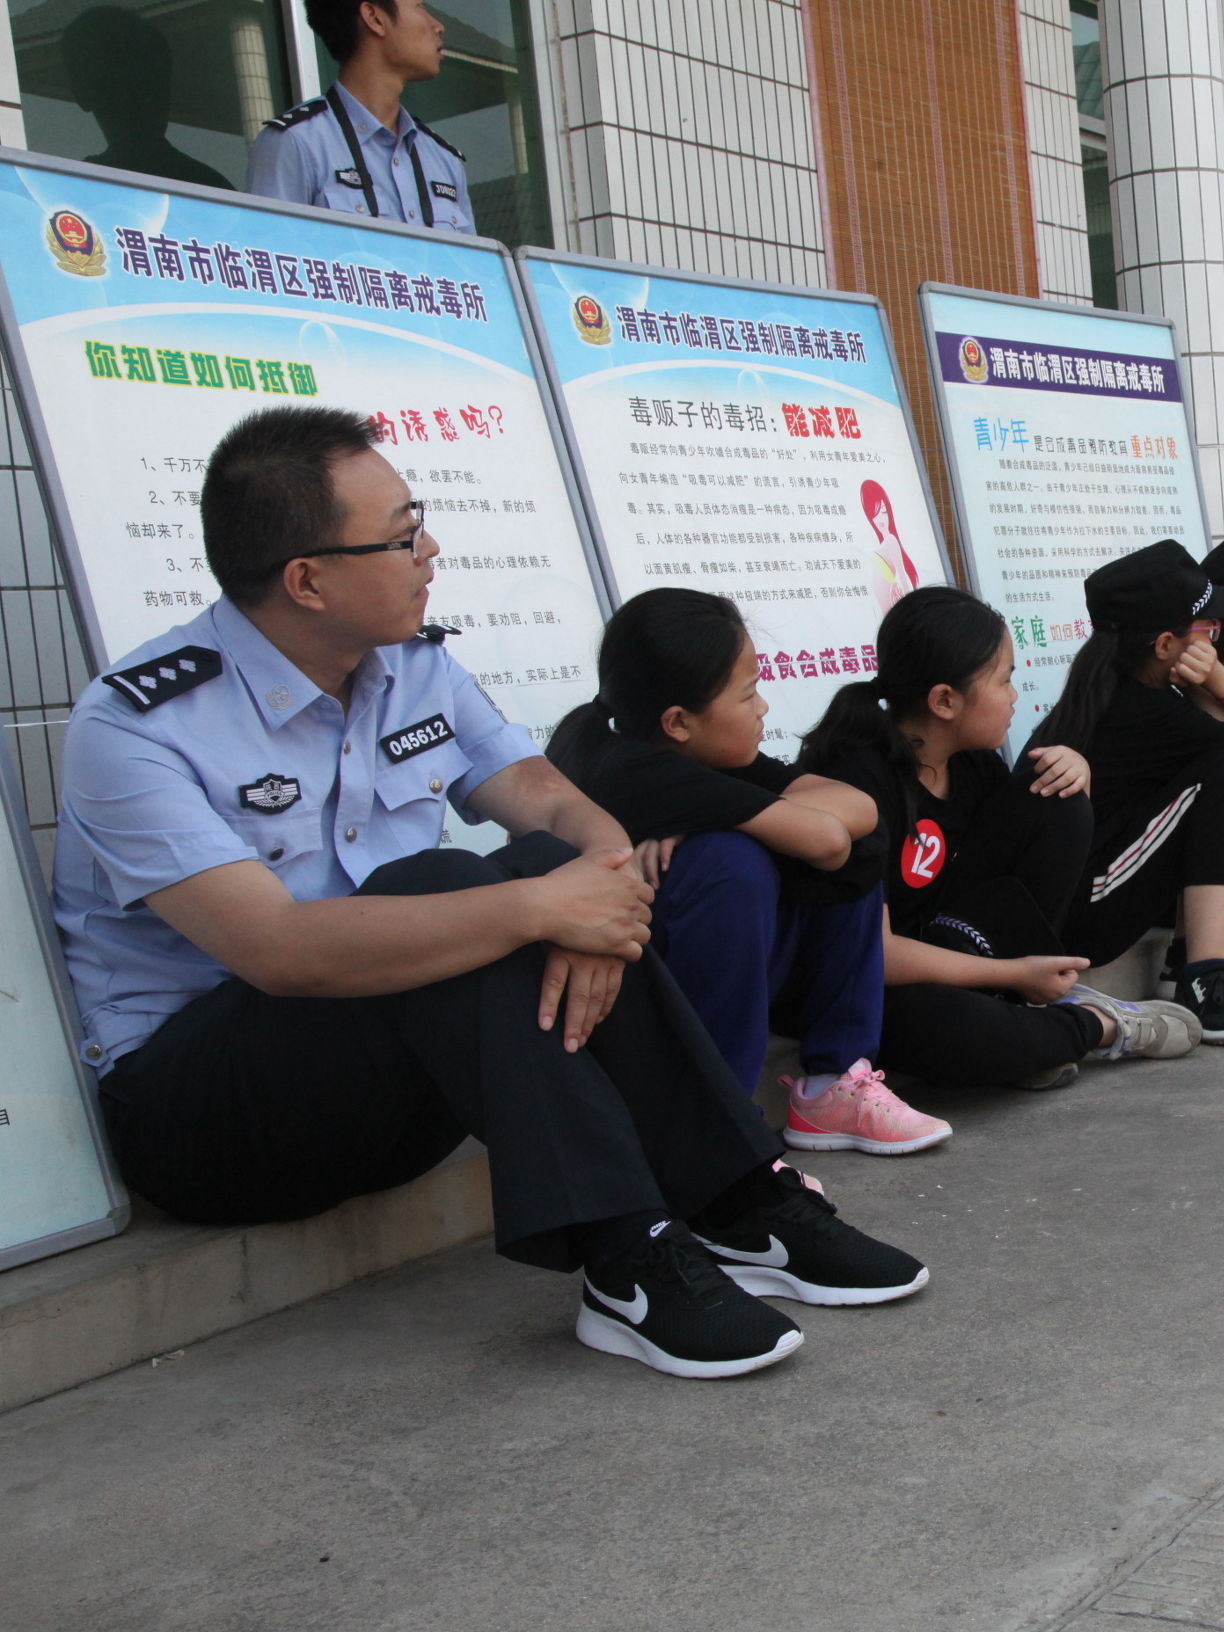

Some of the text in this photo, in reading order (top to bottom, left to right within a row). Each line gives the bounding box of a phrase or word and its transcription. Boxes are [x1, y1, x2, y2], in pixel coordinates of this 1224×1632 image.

[114, 226, 487, 323] 渭南市临渭区强制隔离戒毒所
[616, 306, 867, 363] 渭南市临渭区强制隔离戒毒所
[84, 339, 318, 397] 你知道如何抵御
[990, 346, 1166, 393] 渭南市临渭区强制隔离戒毒所
[973, 417, 1030, 453] 青少年
[1130, 435, 1179, 460] 重点对象
[126, 521, 195, 540] 恼却来了。
[166, 557, 212, 573] 3、不
[143, 590, 212, 607] 药物可救。
[1011, 615, 1048, 650] 家庭
[1073, 618, 1095, 640] 教
[389, 721, 448, 756] 045612
[911, 832, 941, 878] 12
